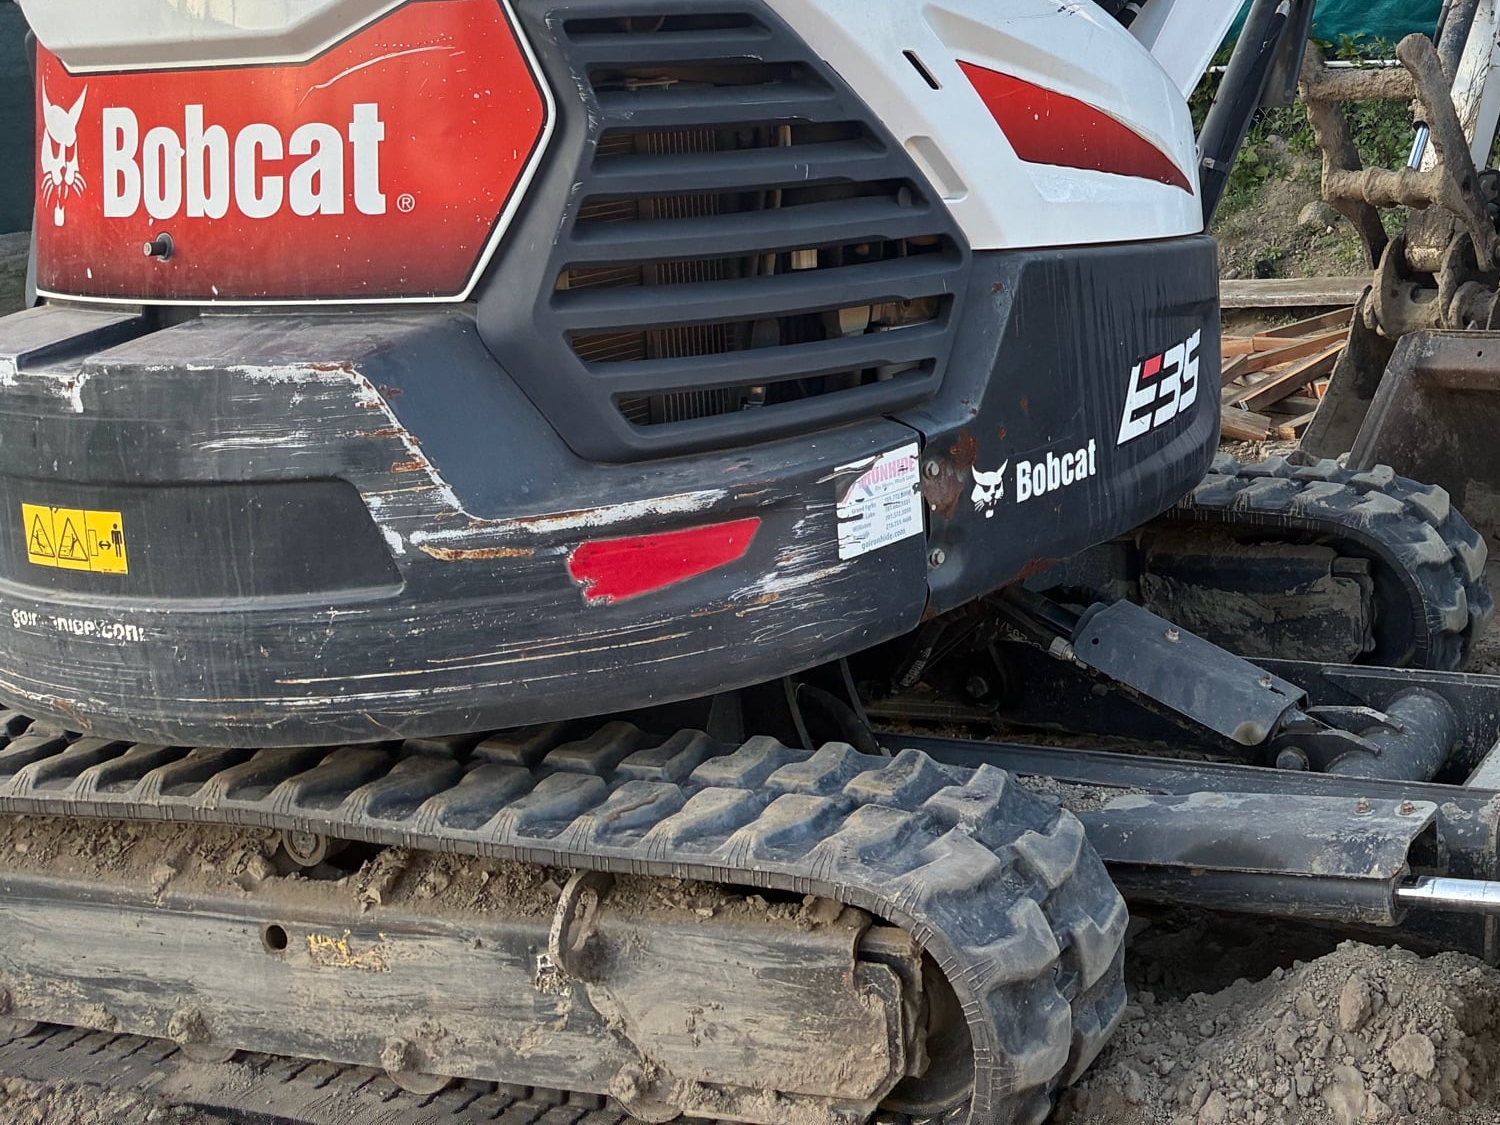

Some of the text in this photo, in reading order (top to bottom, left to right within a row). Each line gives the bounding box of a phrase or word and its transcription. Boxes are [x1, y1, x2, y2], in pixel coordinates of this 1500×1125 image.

[102, 102, 387, 219] Bobcat
[1116, 328, 1202, 446] E35
[1015, 437, 1097, 504] Bobcat
[861, 528, 906, 551] goironhide.com
